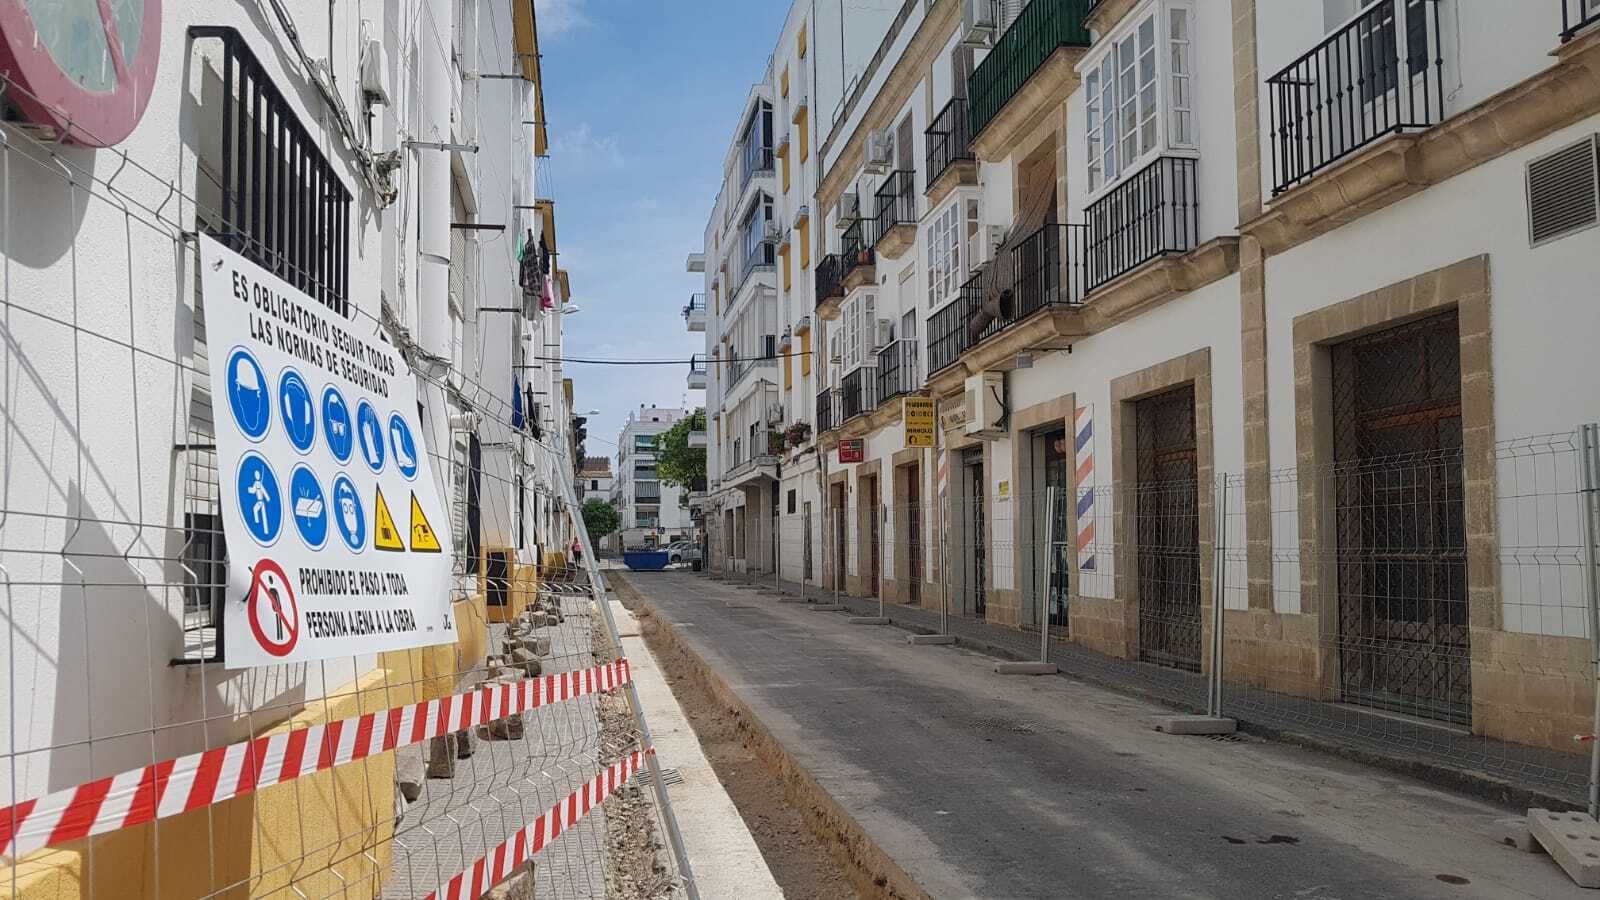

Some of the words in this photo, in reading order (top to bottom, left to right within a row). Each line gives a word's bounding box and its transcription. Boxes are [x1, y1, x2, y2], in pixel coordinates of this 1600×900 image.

[232, 270, 248, 302] ES
[253, 282, 329, 343] OBLIGATORIO
[332, 325, 365, 363] SEGUIR
[366, 345, 395, 377] TODAS
[249, 312, 273, 346] LAS
[276, 326, 323, 368] NORMAS
[325, 349, 339, 376] DE
[341, 358, 389, 398] SEGURIDAD
[299, 568, 347, 596] PROHIBIDO
[349, 570, 359, 595] EL
[359, 571, 380, 596] PASO
[380, 573, 388, 595] A
[387, 573, 409, 596] TODA
[305, 611, 348, 638] PERSONA
[349, 610, 376, 635] AJENA
[375, 610, 383, 634] A
[382, 610, 393, 633] LA
[393, 609, 417, 632] OBRA
